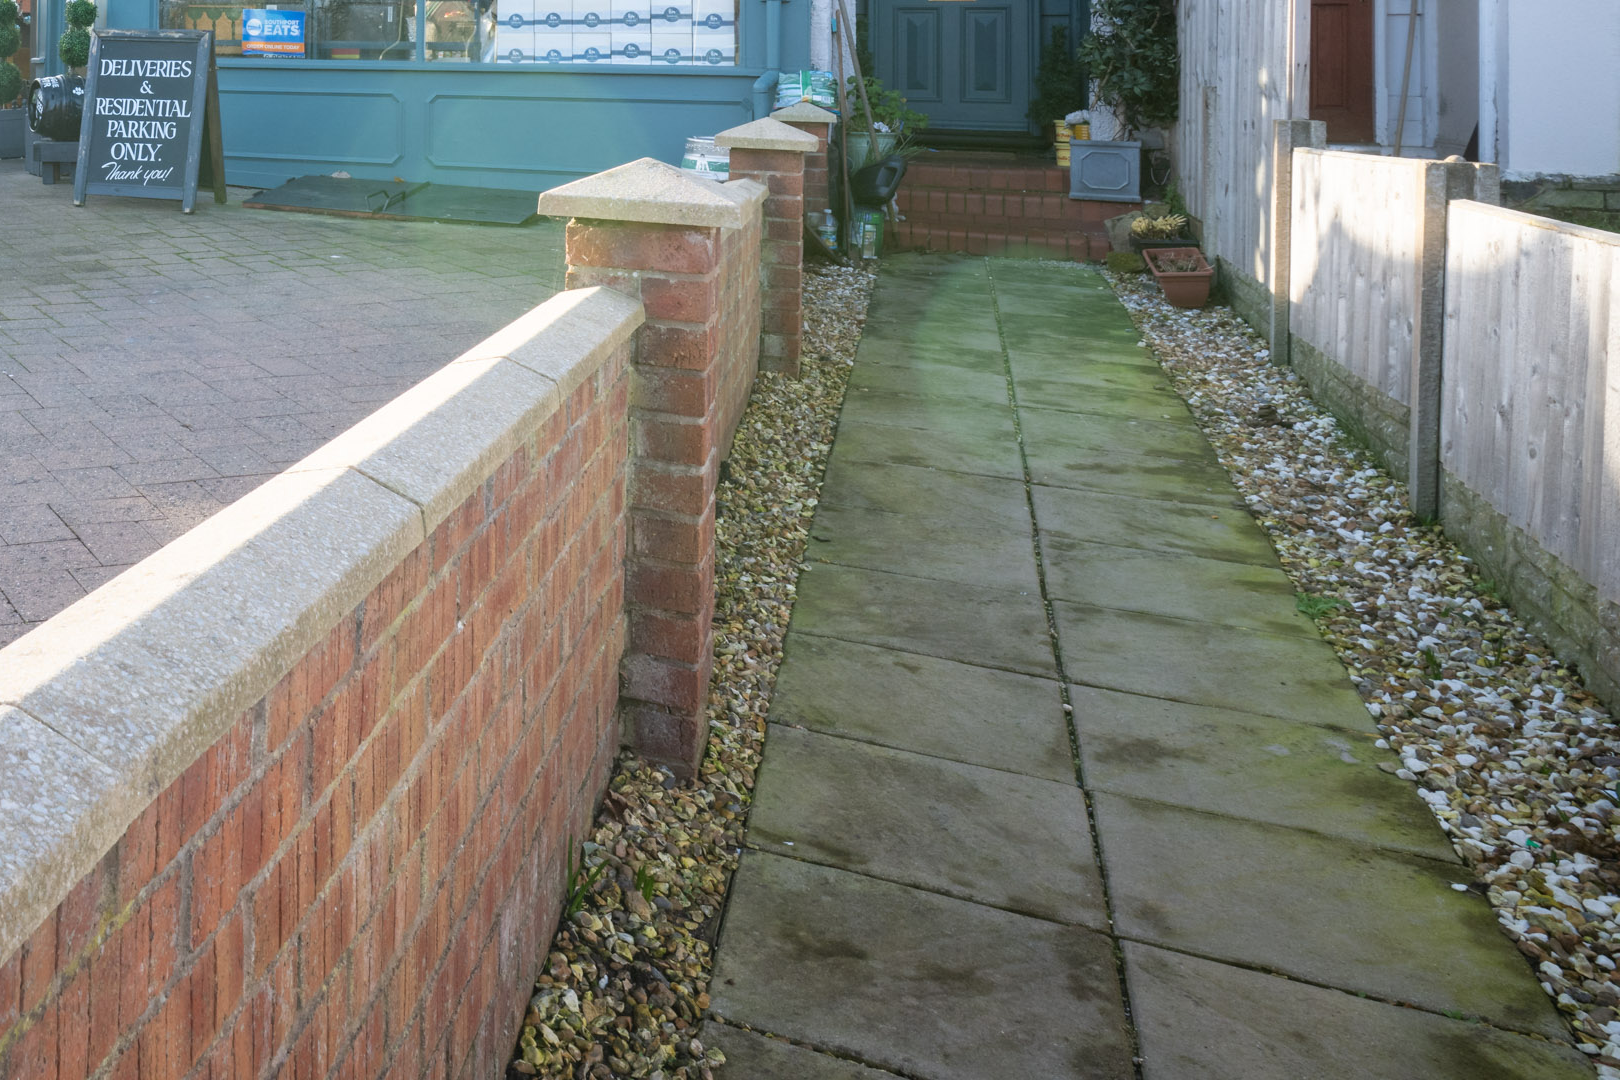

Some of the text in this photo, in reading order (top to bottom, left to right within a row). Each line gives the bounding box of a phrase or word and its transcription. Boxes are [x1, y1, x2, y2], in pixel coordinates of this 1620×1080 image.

[264, 24, 300, 36] EATS
[100, 59, 192, 78] DELIVERIES
[139, 80, 154, 95] &
[95, 97, 191, 118] RESIDENTIAL
[106, 120, 177, 140] PARKING
[110, 142, 163, 162] ONLY.
[101, 161, 174, 186] Thank you!
